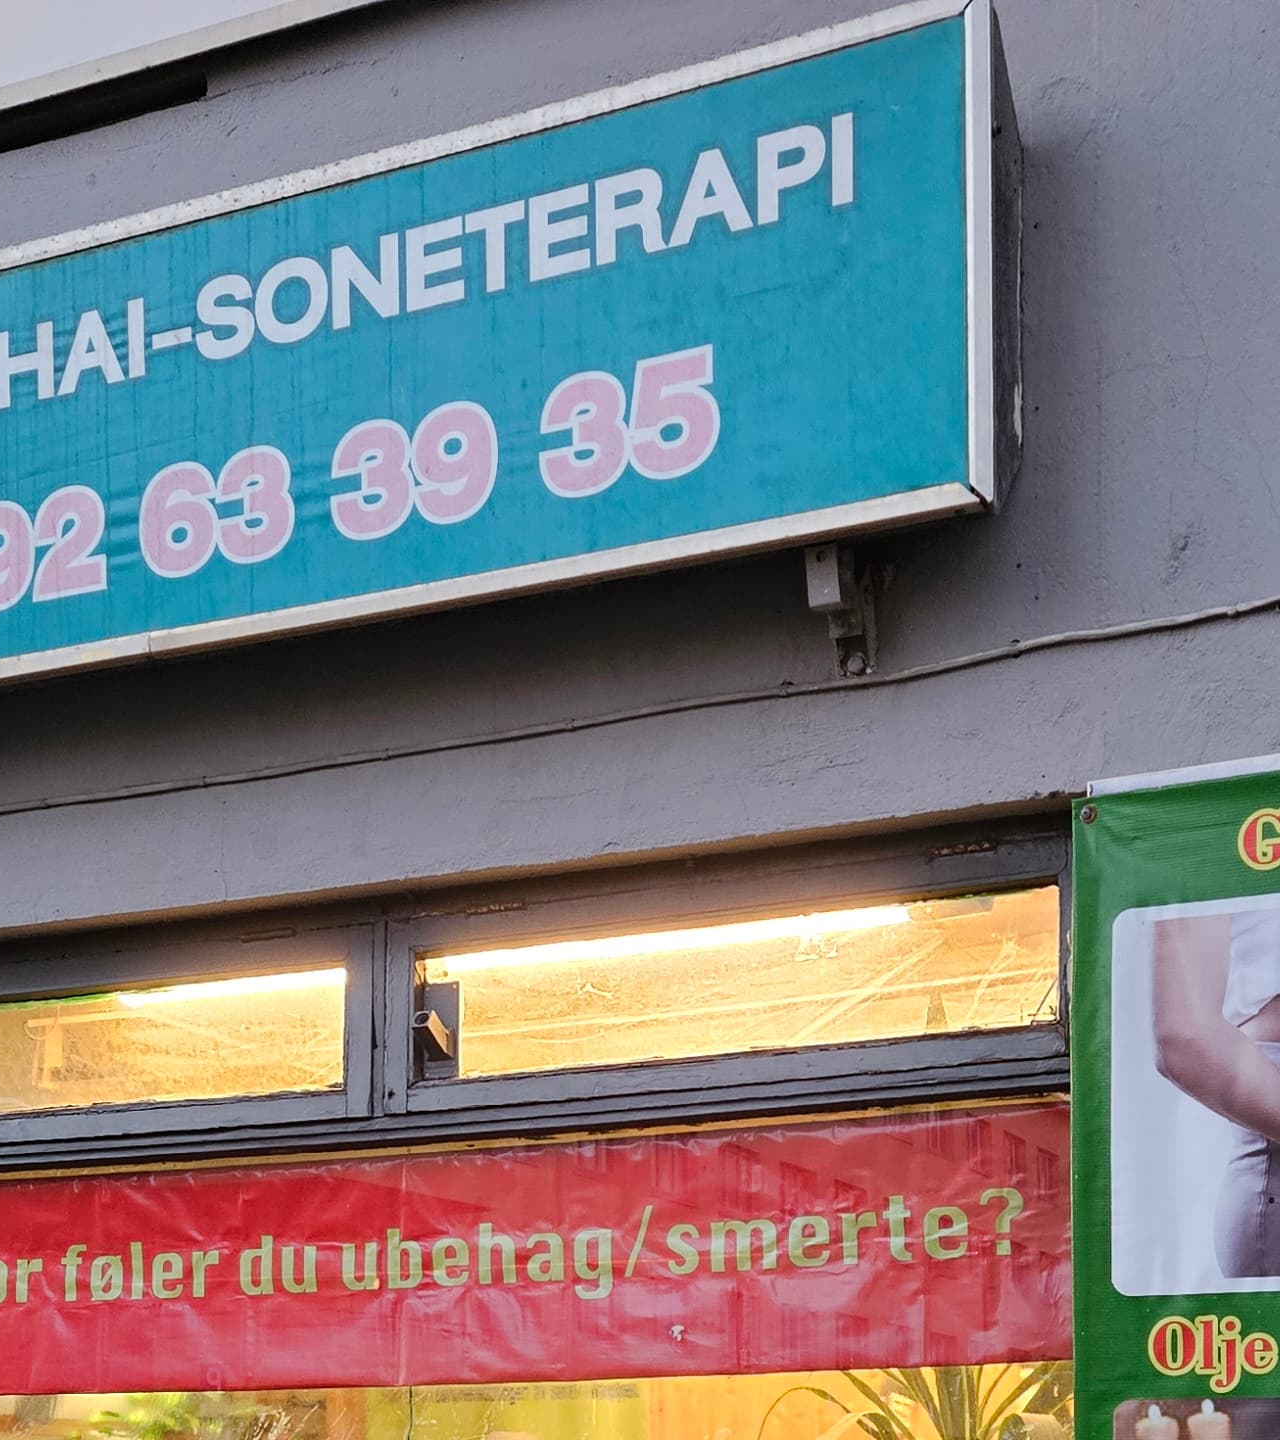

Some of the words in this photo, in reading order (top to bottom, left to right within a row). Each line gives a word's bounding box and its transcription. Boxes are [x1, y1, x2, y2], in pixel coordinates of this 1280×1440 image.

[139, 444, 296, 580] 63
[330, 400, 499, 543] 39
[538, 343, 721, 499] 35
[61, 1241, 220, 1302] føler
[239, 1234, 318, 1296] du
[341, 1187, 1024, 1301] ubehag/smerte?
[1147, 1314, 1278, 1394] Olje
